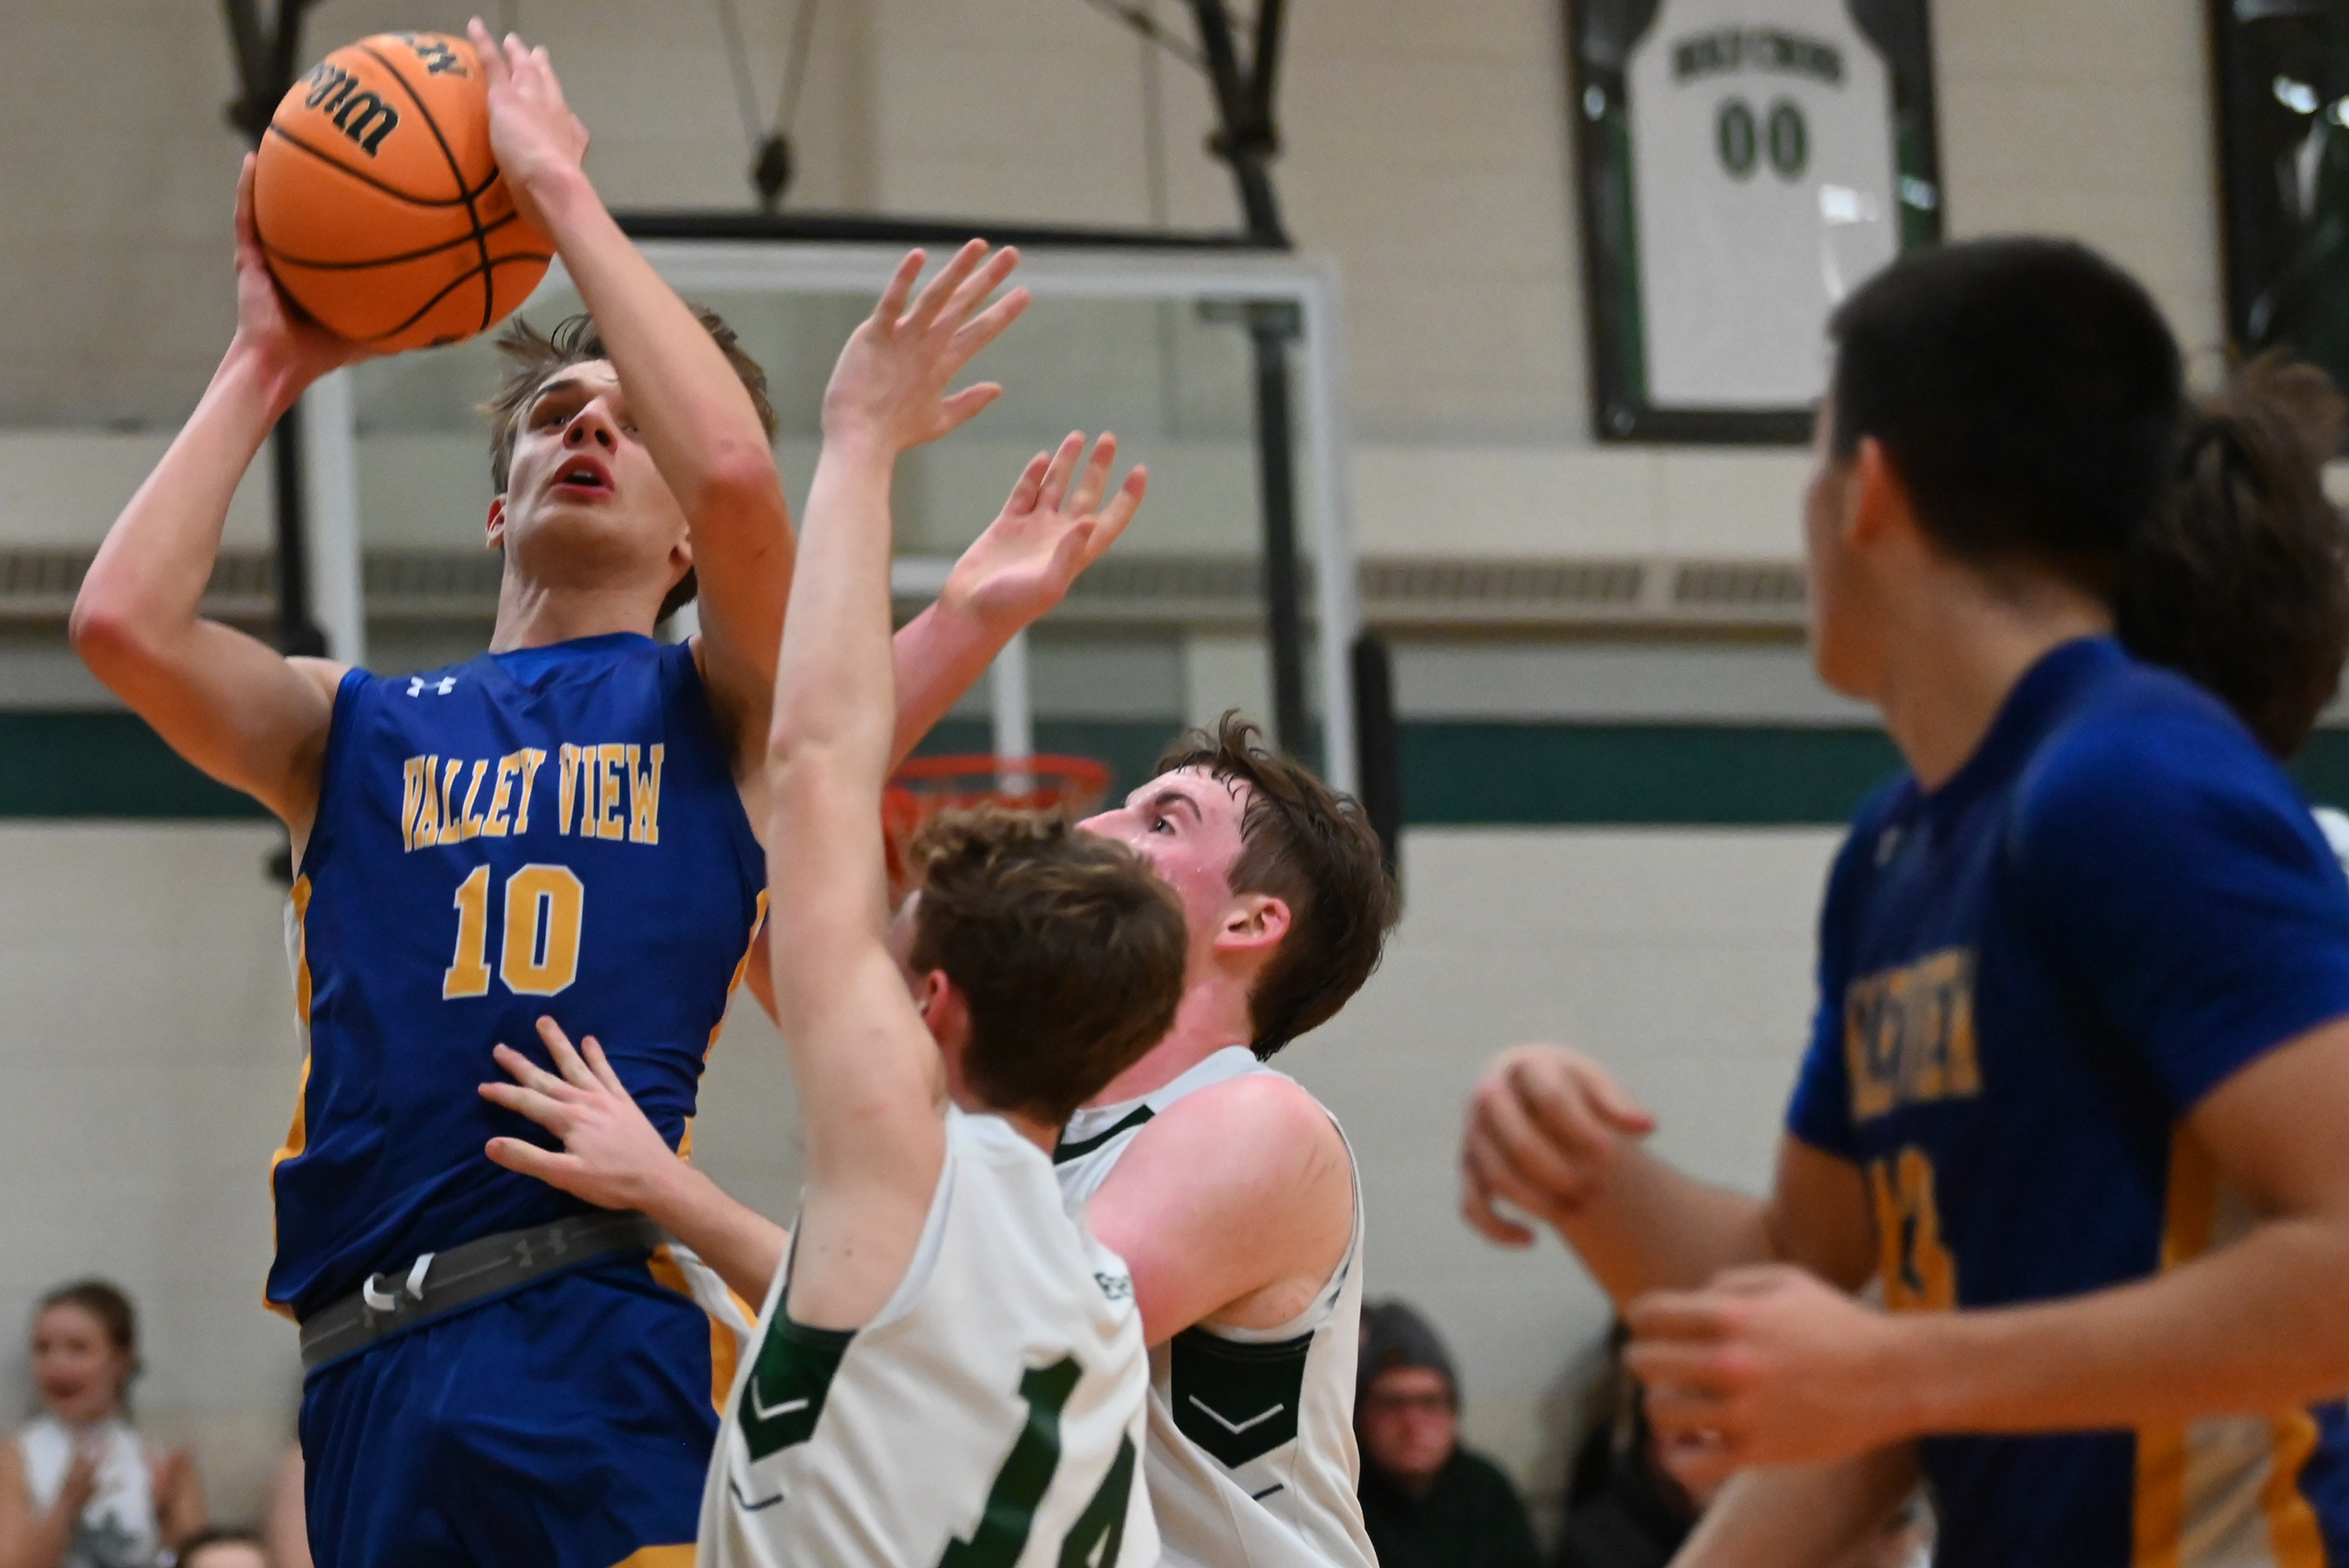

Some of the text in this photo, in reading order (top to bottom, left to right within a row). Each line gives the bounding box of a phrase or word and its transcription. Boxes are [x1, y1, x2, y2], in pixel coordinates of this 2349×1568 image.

[1717, 97, 1808, 178] 00
[402, 742, 665, 853] VALLEY VIEW
[442, 863, 585, 1000] 10
